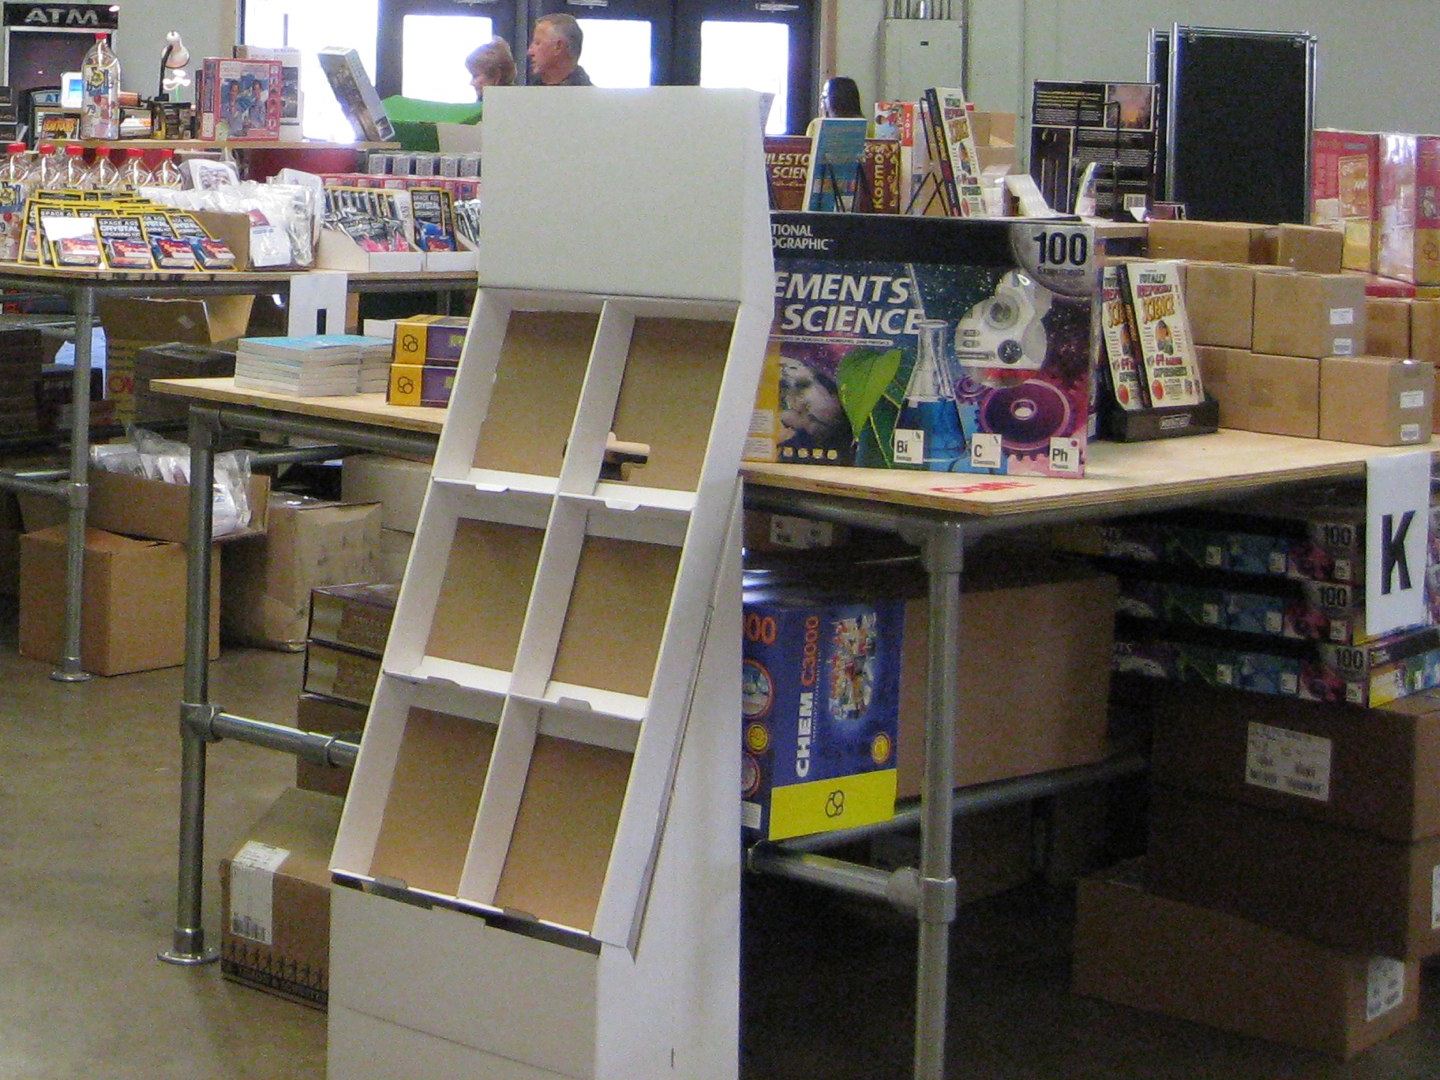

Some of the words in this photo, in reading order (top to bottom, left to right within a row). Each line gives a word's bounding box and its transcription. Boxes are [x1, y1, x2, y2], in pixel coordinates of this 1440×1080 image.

[25, 8, 99, 25] ATM
[45, 94, 60, 103] AT
[771, 166, 809, 179] SCIEN
[1033, 231, 1087, 265] 100
[781, 304, 924, 335] SCIENCE
[896, 440, 908, 454] Bi
[974, 444, 982, 458] C
[1052, 448, 1068, 461] Ph
[1380, 510, 1416, 595] K
[801, 615, 820, 687] C3000
[796, 692, 813, 778] CHEM
